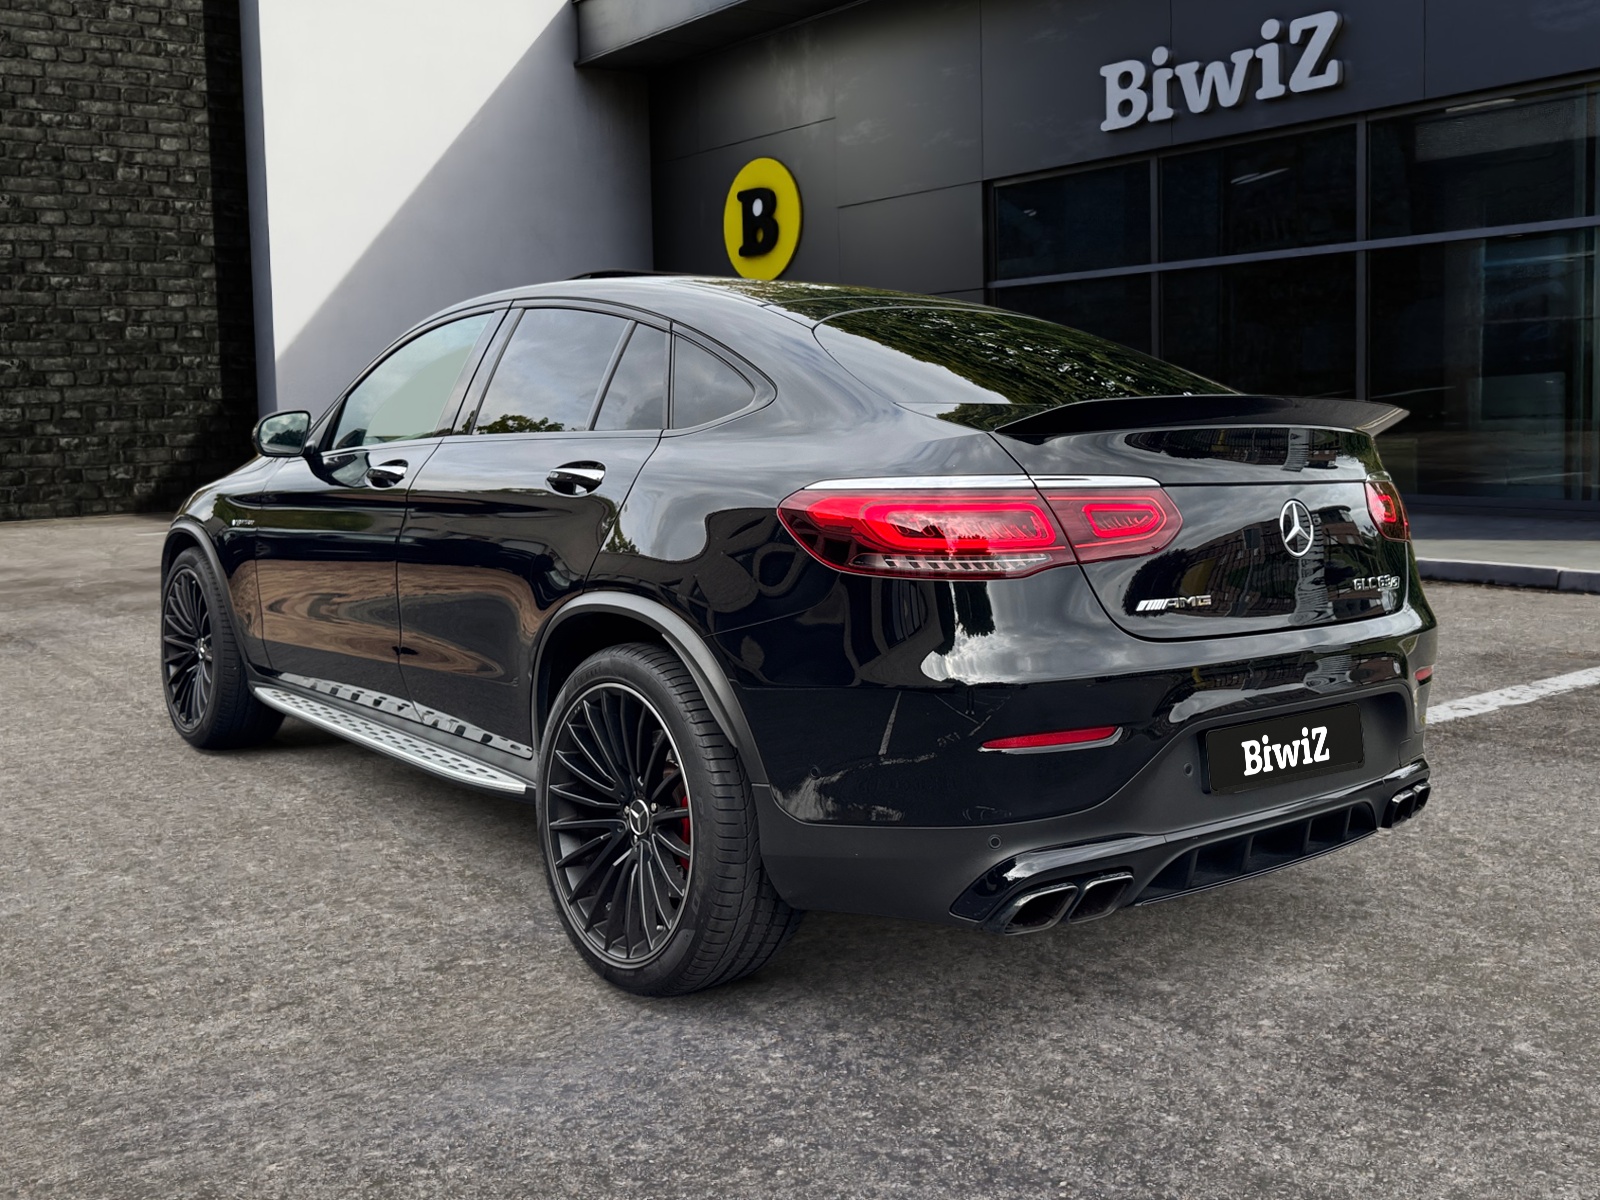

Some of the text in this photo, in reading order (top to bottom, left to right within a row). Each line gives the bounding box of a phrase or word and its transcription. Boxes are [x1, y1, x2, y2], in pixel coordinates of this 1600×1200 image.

[1100, 10, 1345, 132] BiwiZ
[737, 187, 780, 258] B
[1161, 594, 1212, 610] AMG
[1241, 726, 1330, 776] BiwiZ
